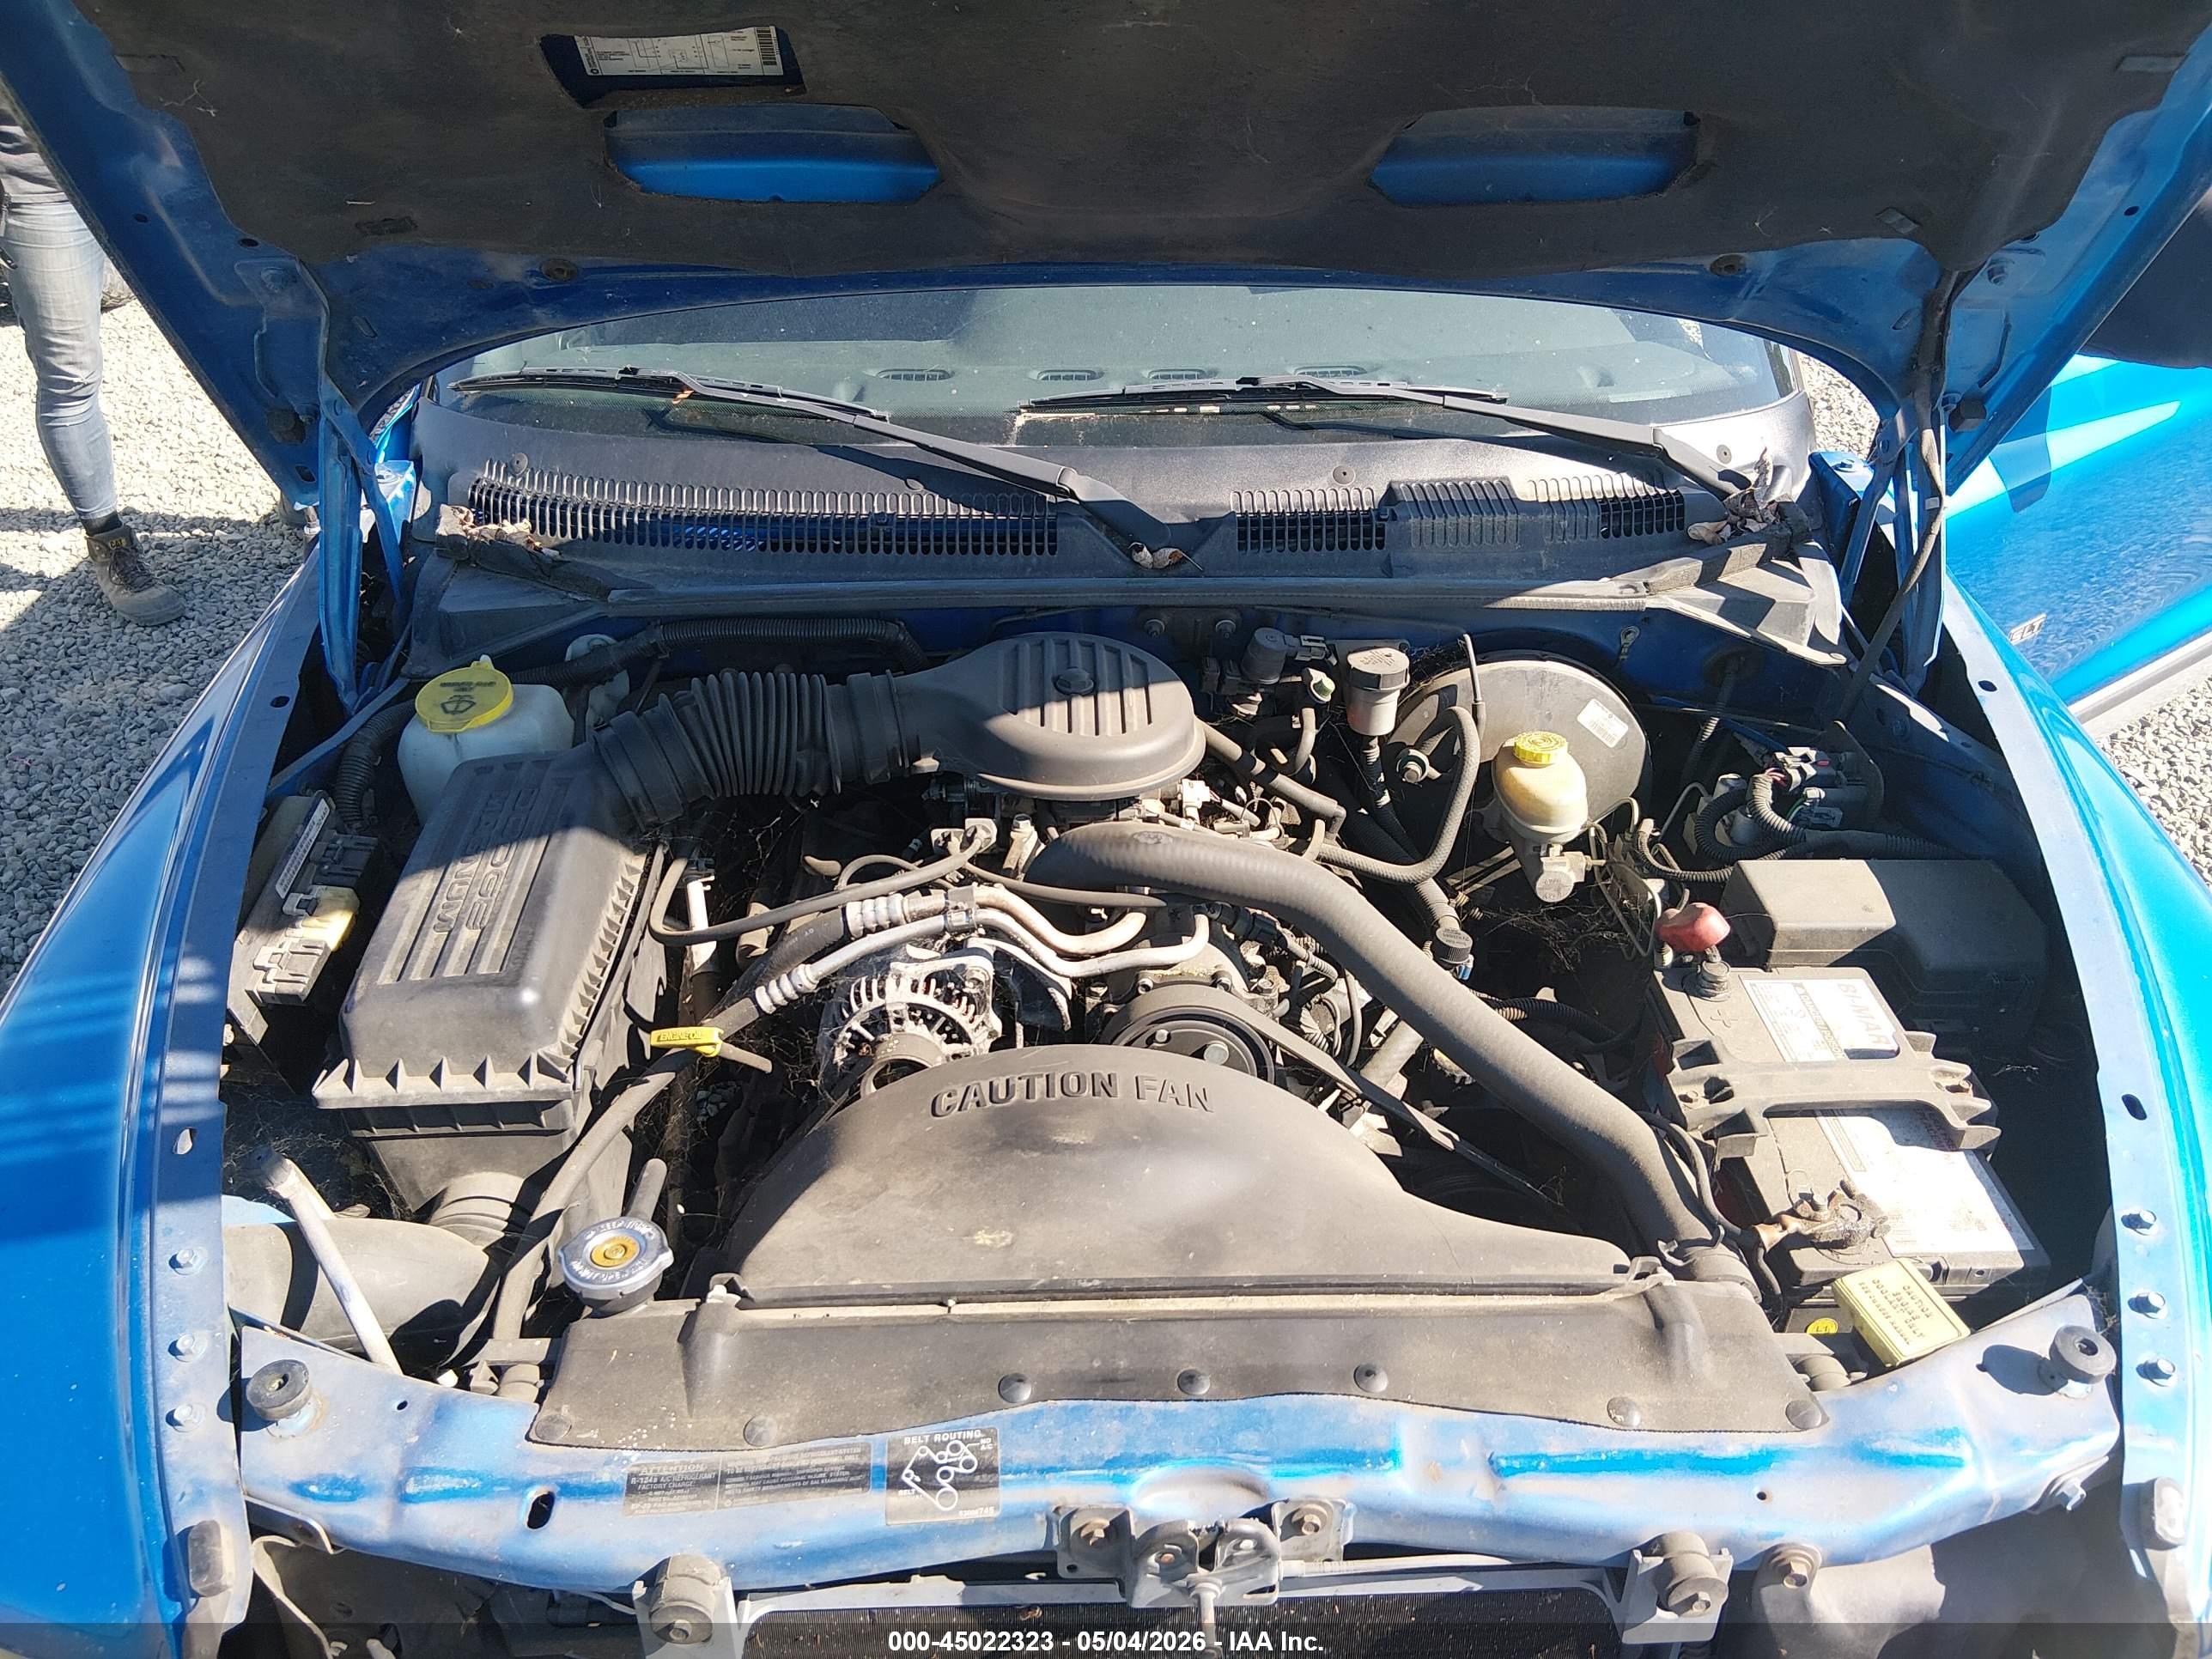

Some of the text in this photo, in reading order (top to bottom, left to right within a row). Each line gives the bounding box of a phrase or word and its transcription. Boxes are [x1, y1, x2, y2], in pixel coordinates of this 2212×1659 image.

[110, 538, 123, 549] CAT
[433, 791, 510, 933] MAGNUM
[466, 788, 540, 930] DODGE
[1836, 982, 1892, 1045] BI-MAR
[657, 1031, 702, 1042] ENGINE OIL
[930, 1071, 1215, 1118] CAUTION FAN
[903, 1429, 981, 1444] BELT ROUTING
[638, 1482, 666, 1491] FACTORY
